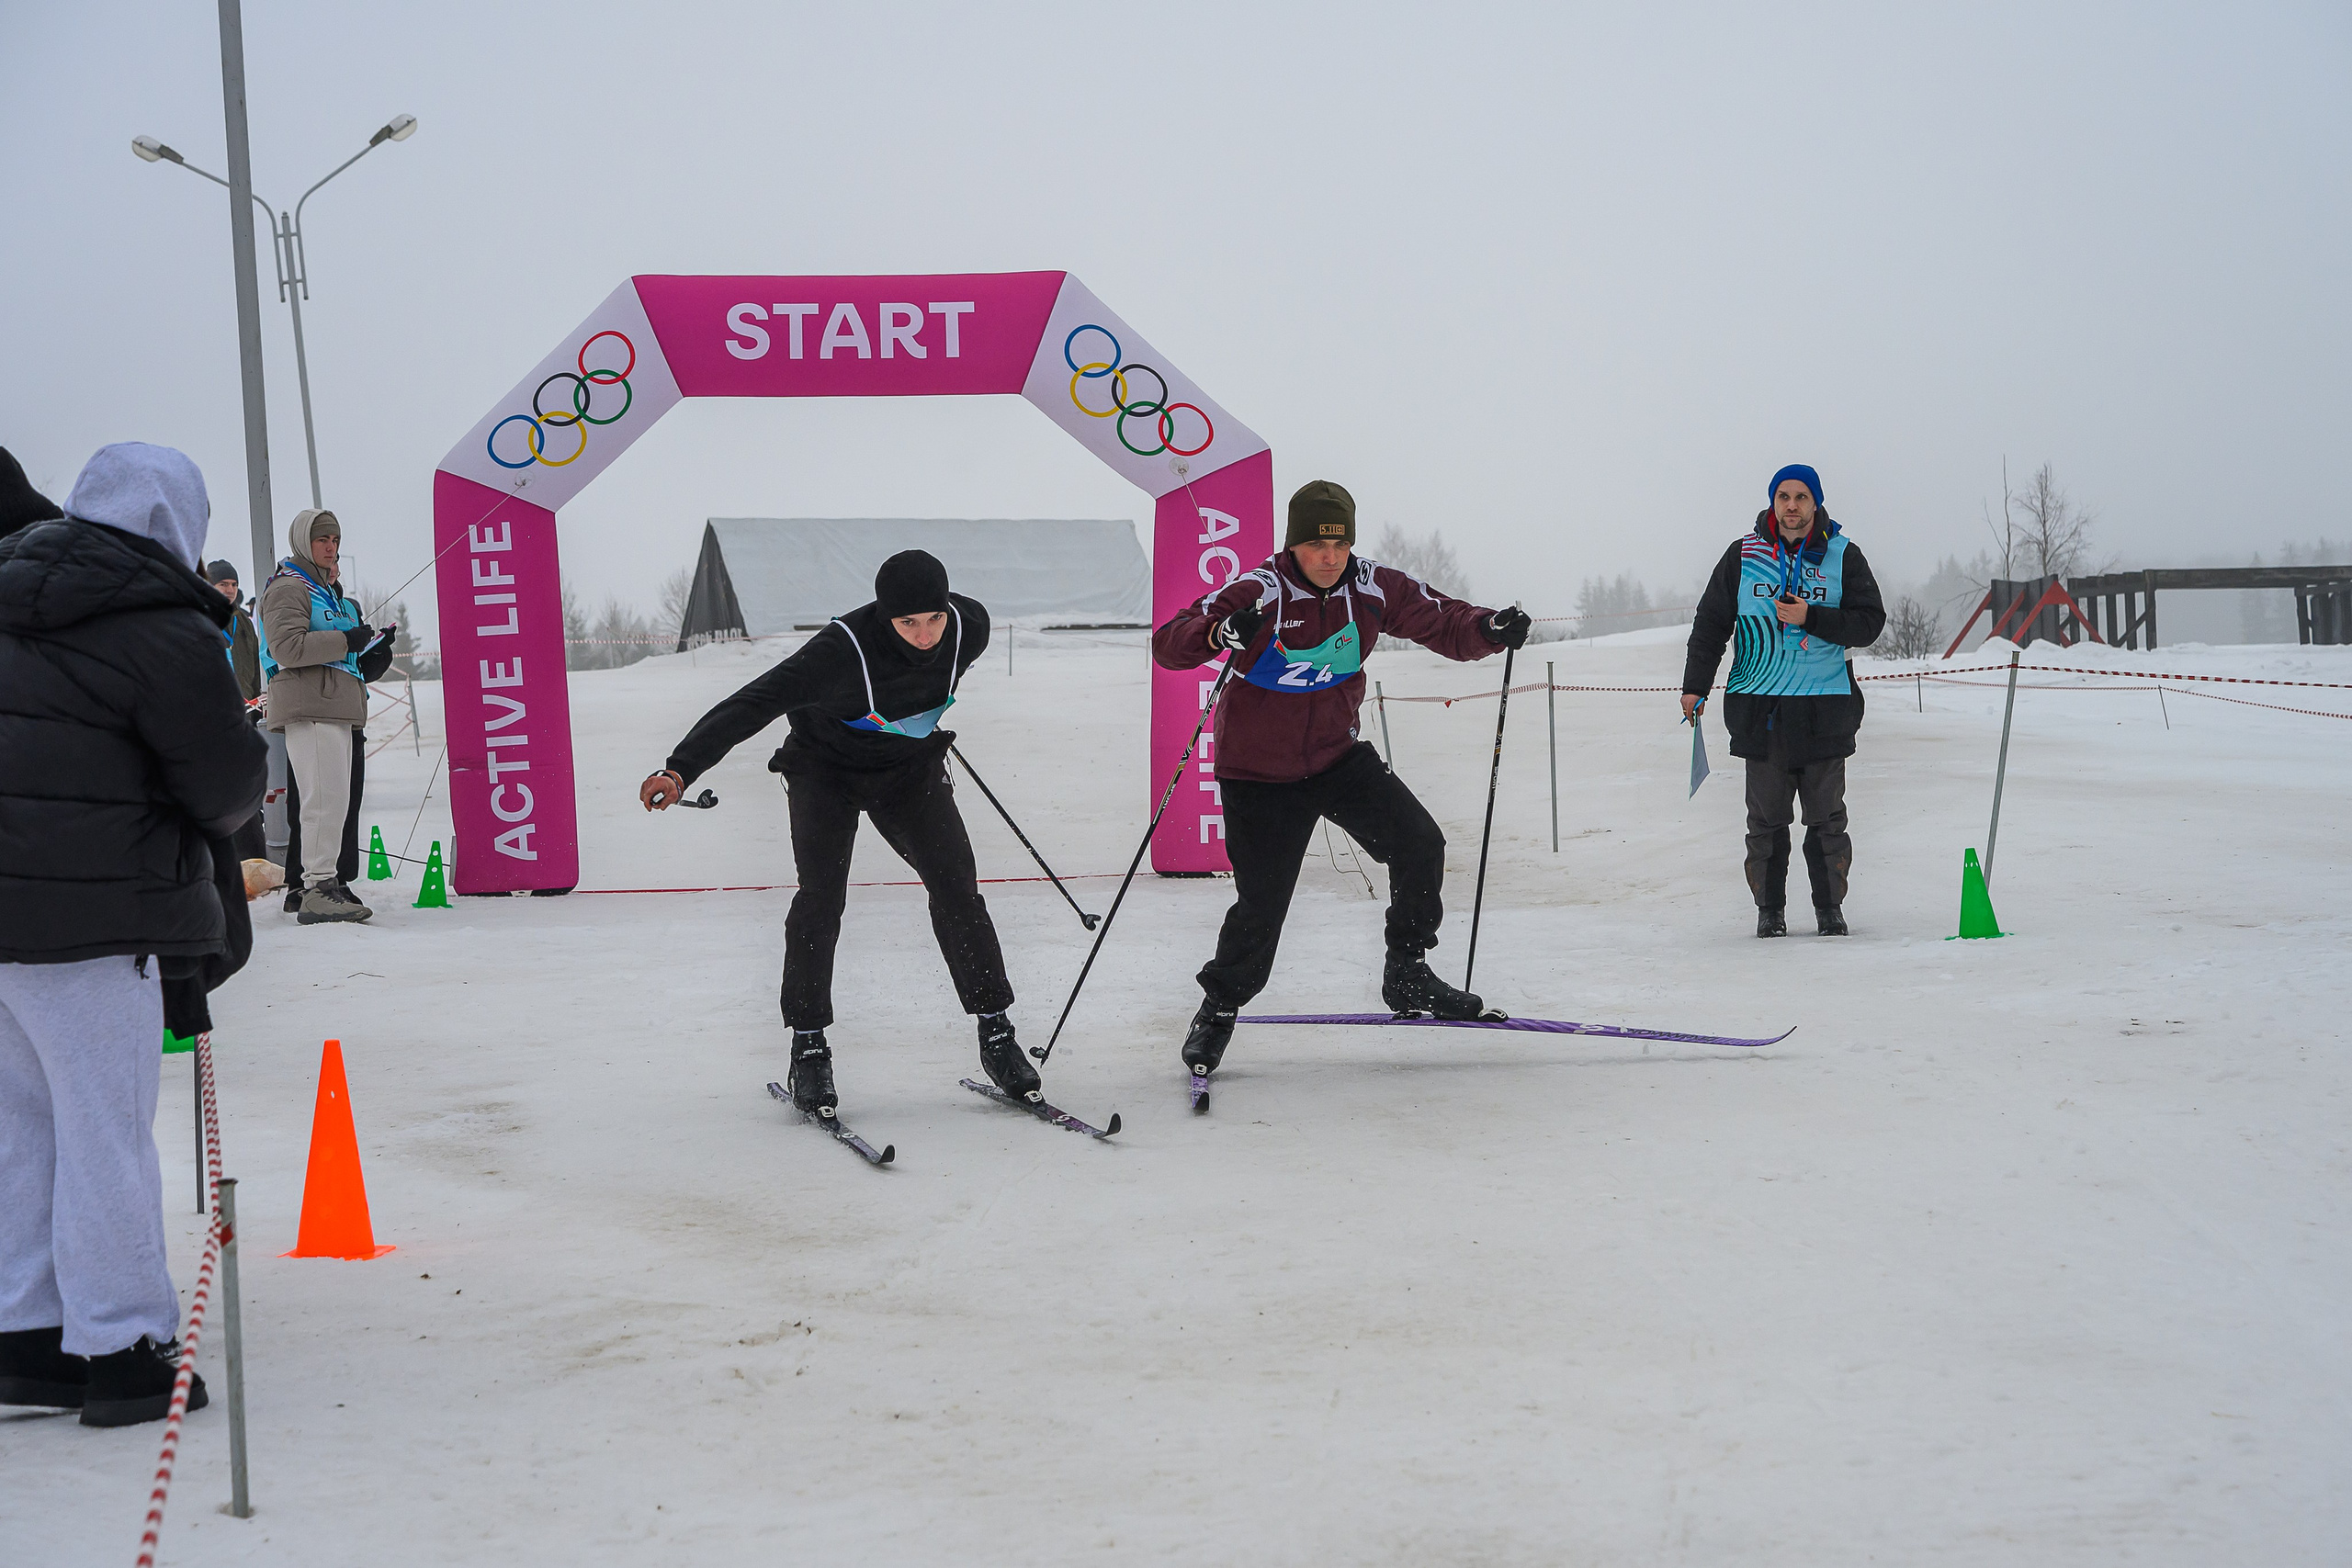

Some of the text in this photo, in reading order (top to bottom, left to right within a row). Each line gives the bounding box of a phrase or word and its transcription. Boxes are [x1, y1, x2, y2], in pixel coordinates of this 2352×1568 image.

[725, 301, 975, 360] START
[1753, 582, 1827, 602] СУЬЯ
[469, 522, 537, 861] ACTIVE LIFE
[1277, 661, 1334, 687] 2.4
